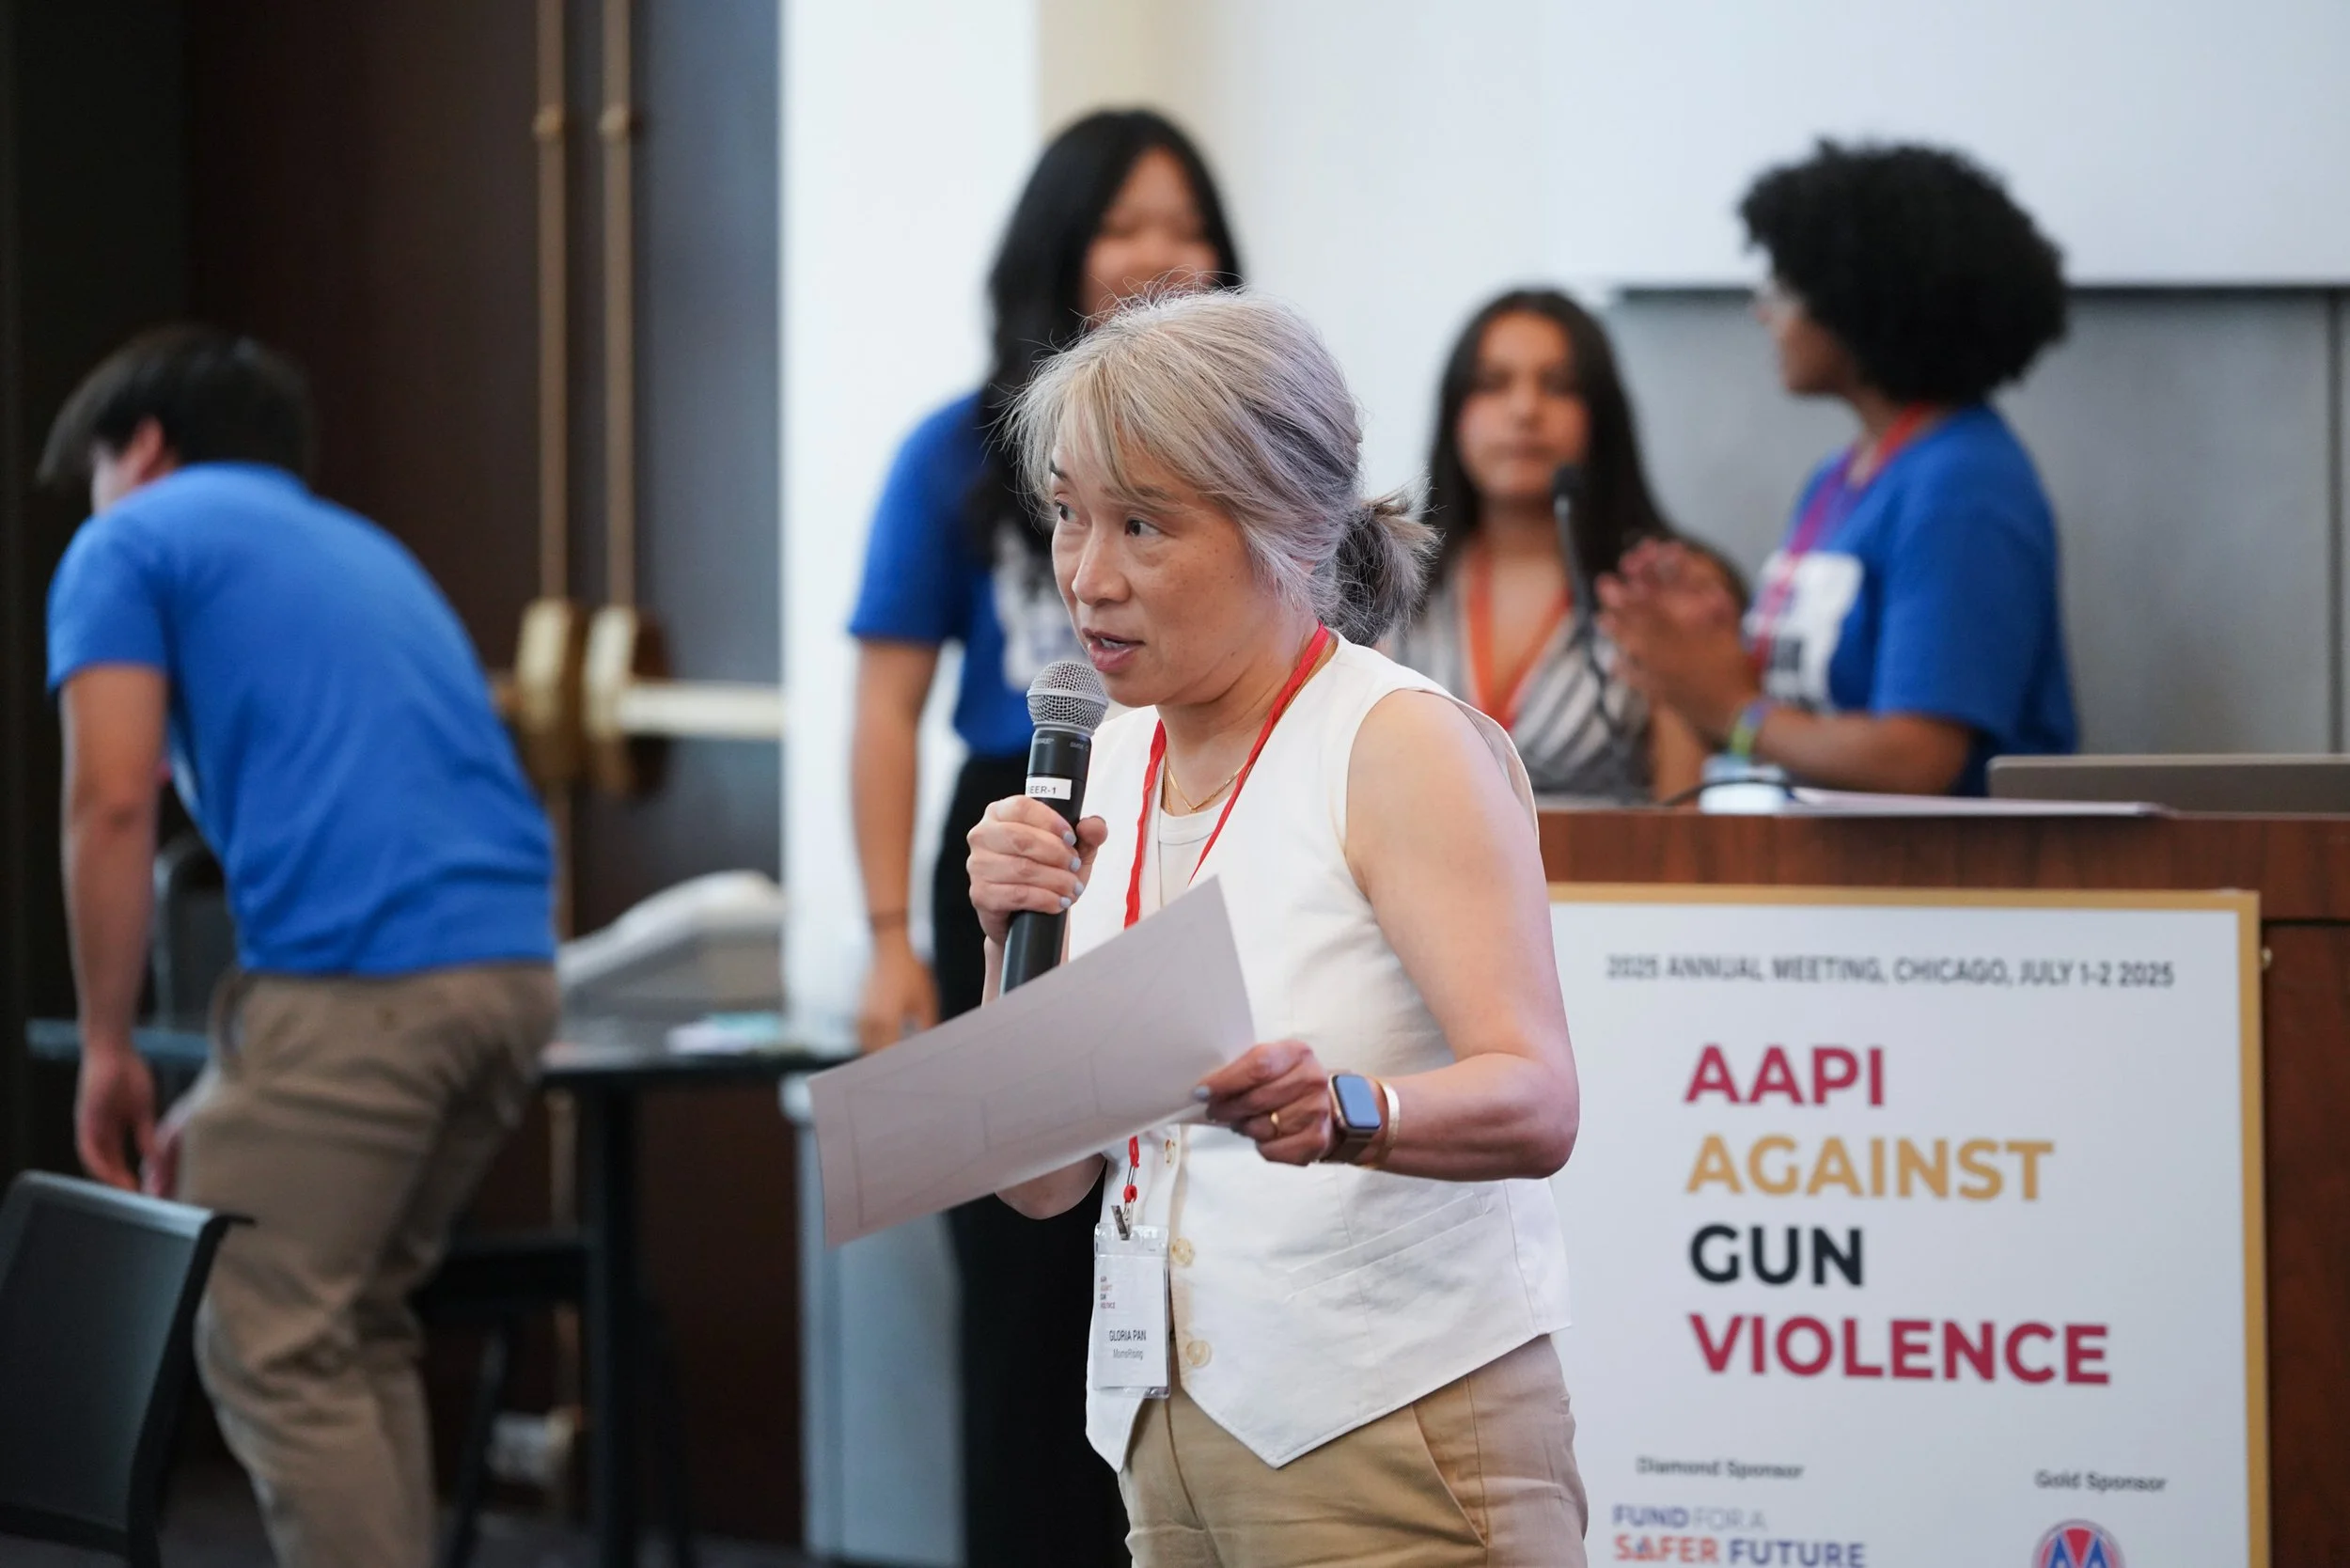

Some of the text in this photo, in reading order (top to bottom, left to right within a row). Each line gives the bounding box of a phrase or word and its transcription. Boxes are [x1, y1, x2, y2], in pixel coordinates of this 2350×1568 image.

[1027, 785, 1057, 794] EER-1
[1606, 954, 2174, 988] 2025 ANNUAL MEETING, CHICAGO, JULY 1-2 2025
[1684, 1044, 1886, 1107] AAPI
[1685, 1134, 2055, 1201] AGAINST
[1688, 1224, 1865, 1288] GUN
[1109, 1330, 1147, 1341] GLORIA PAN
[1688, 1312, 2111, 1385] VIOLENCE
[1636, 1456, 1804, 1482] Diamond Sponsor
[2034, 1468, 2168, 1494] Gold Sponsor
[1612, 1505, 1767, 1532] FUND FOR A
[1614, 1535, 1867, 1568] SAFER FUTURE
